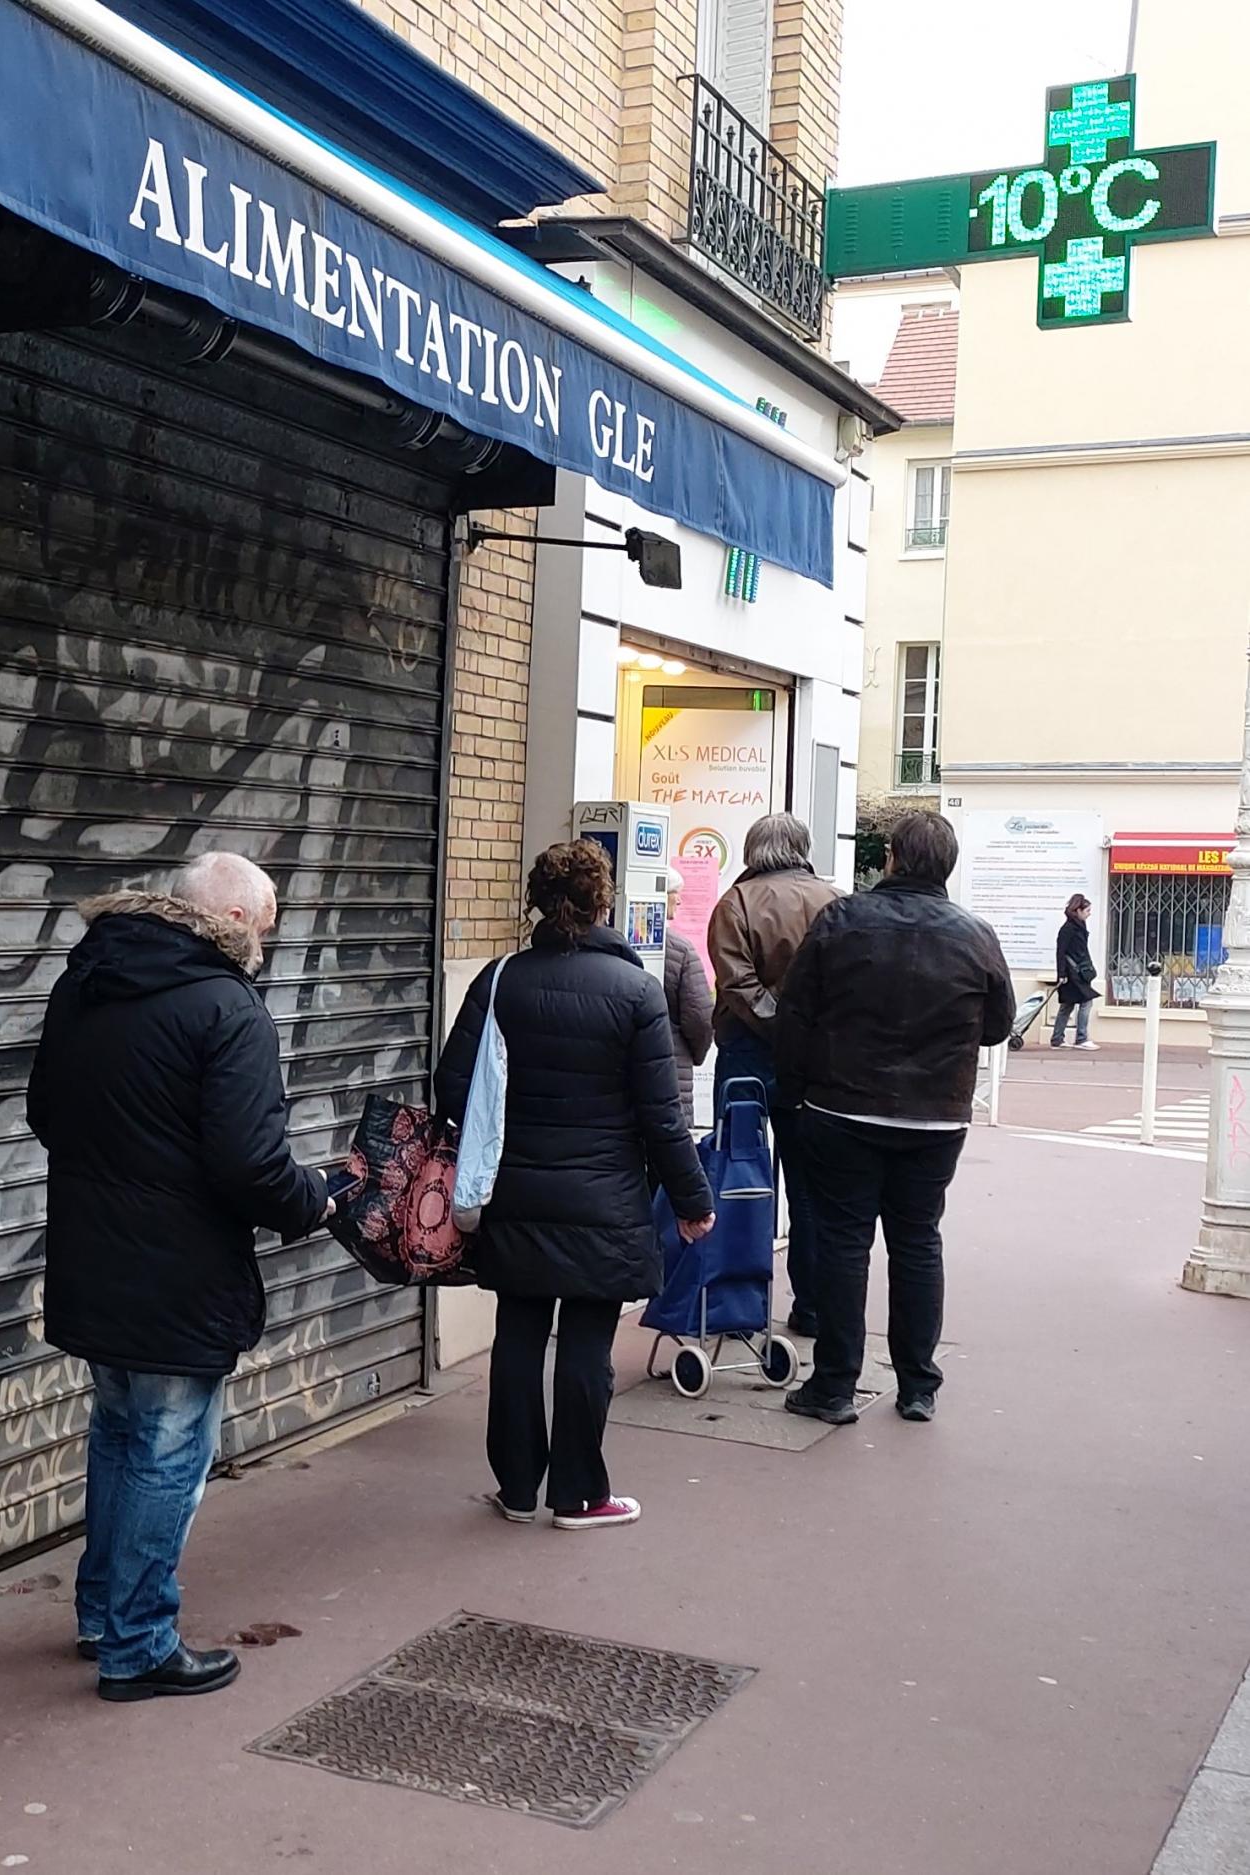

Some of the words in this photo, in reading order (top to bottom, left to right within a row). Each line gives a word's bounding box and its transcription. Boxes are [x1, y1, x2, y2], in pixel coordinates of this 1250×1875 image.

[129, 137, 563, 437] ALIMENTATION
[588, 389, 656, 483] GLE
[696, 746, 767, 763] MEDICAL
[651, 771, 680, 784] Goût
[692, 789, 764, 805] MATCHA
[638, 826, 662, 848] durex
[1198, 850, 1220, 863] LES
